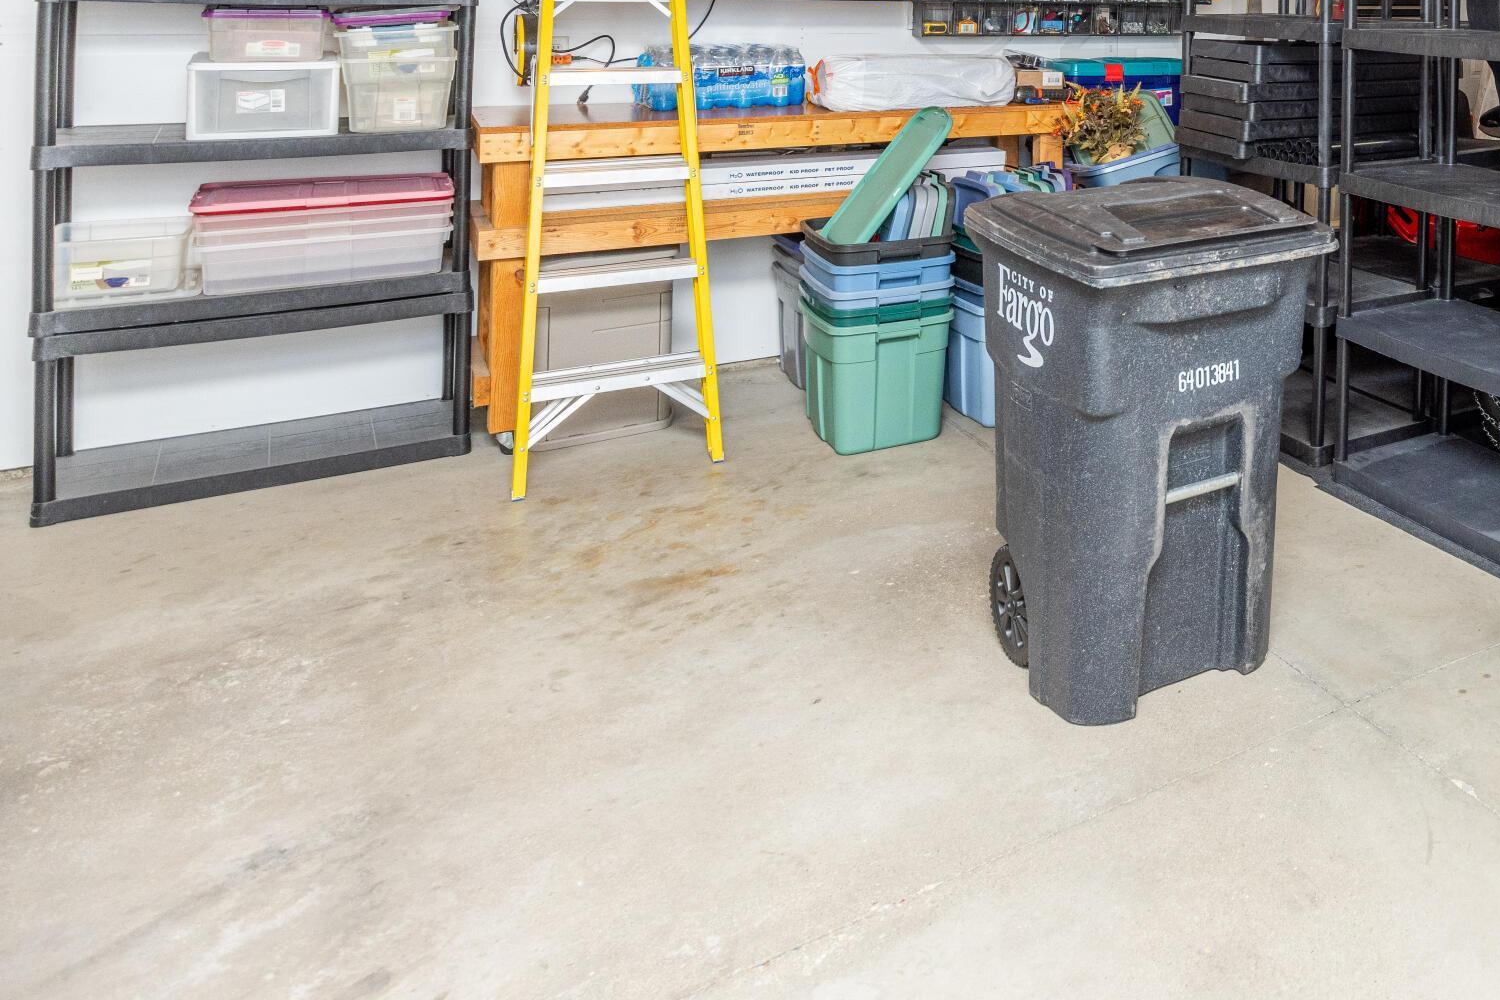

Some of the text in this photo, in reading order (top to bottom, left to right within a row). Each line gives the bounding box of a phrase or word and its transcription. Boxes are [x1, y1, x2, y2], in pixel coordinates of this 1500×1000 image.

[746, 185, 784, 193] WATERPROOF
[1011, 271, 1054, 302] CITY OF
[996, 262, 1055, 368] Fargo
[1178, 359, 1240, 393] 64013841
